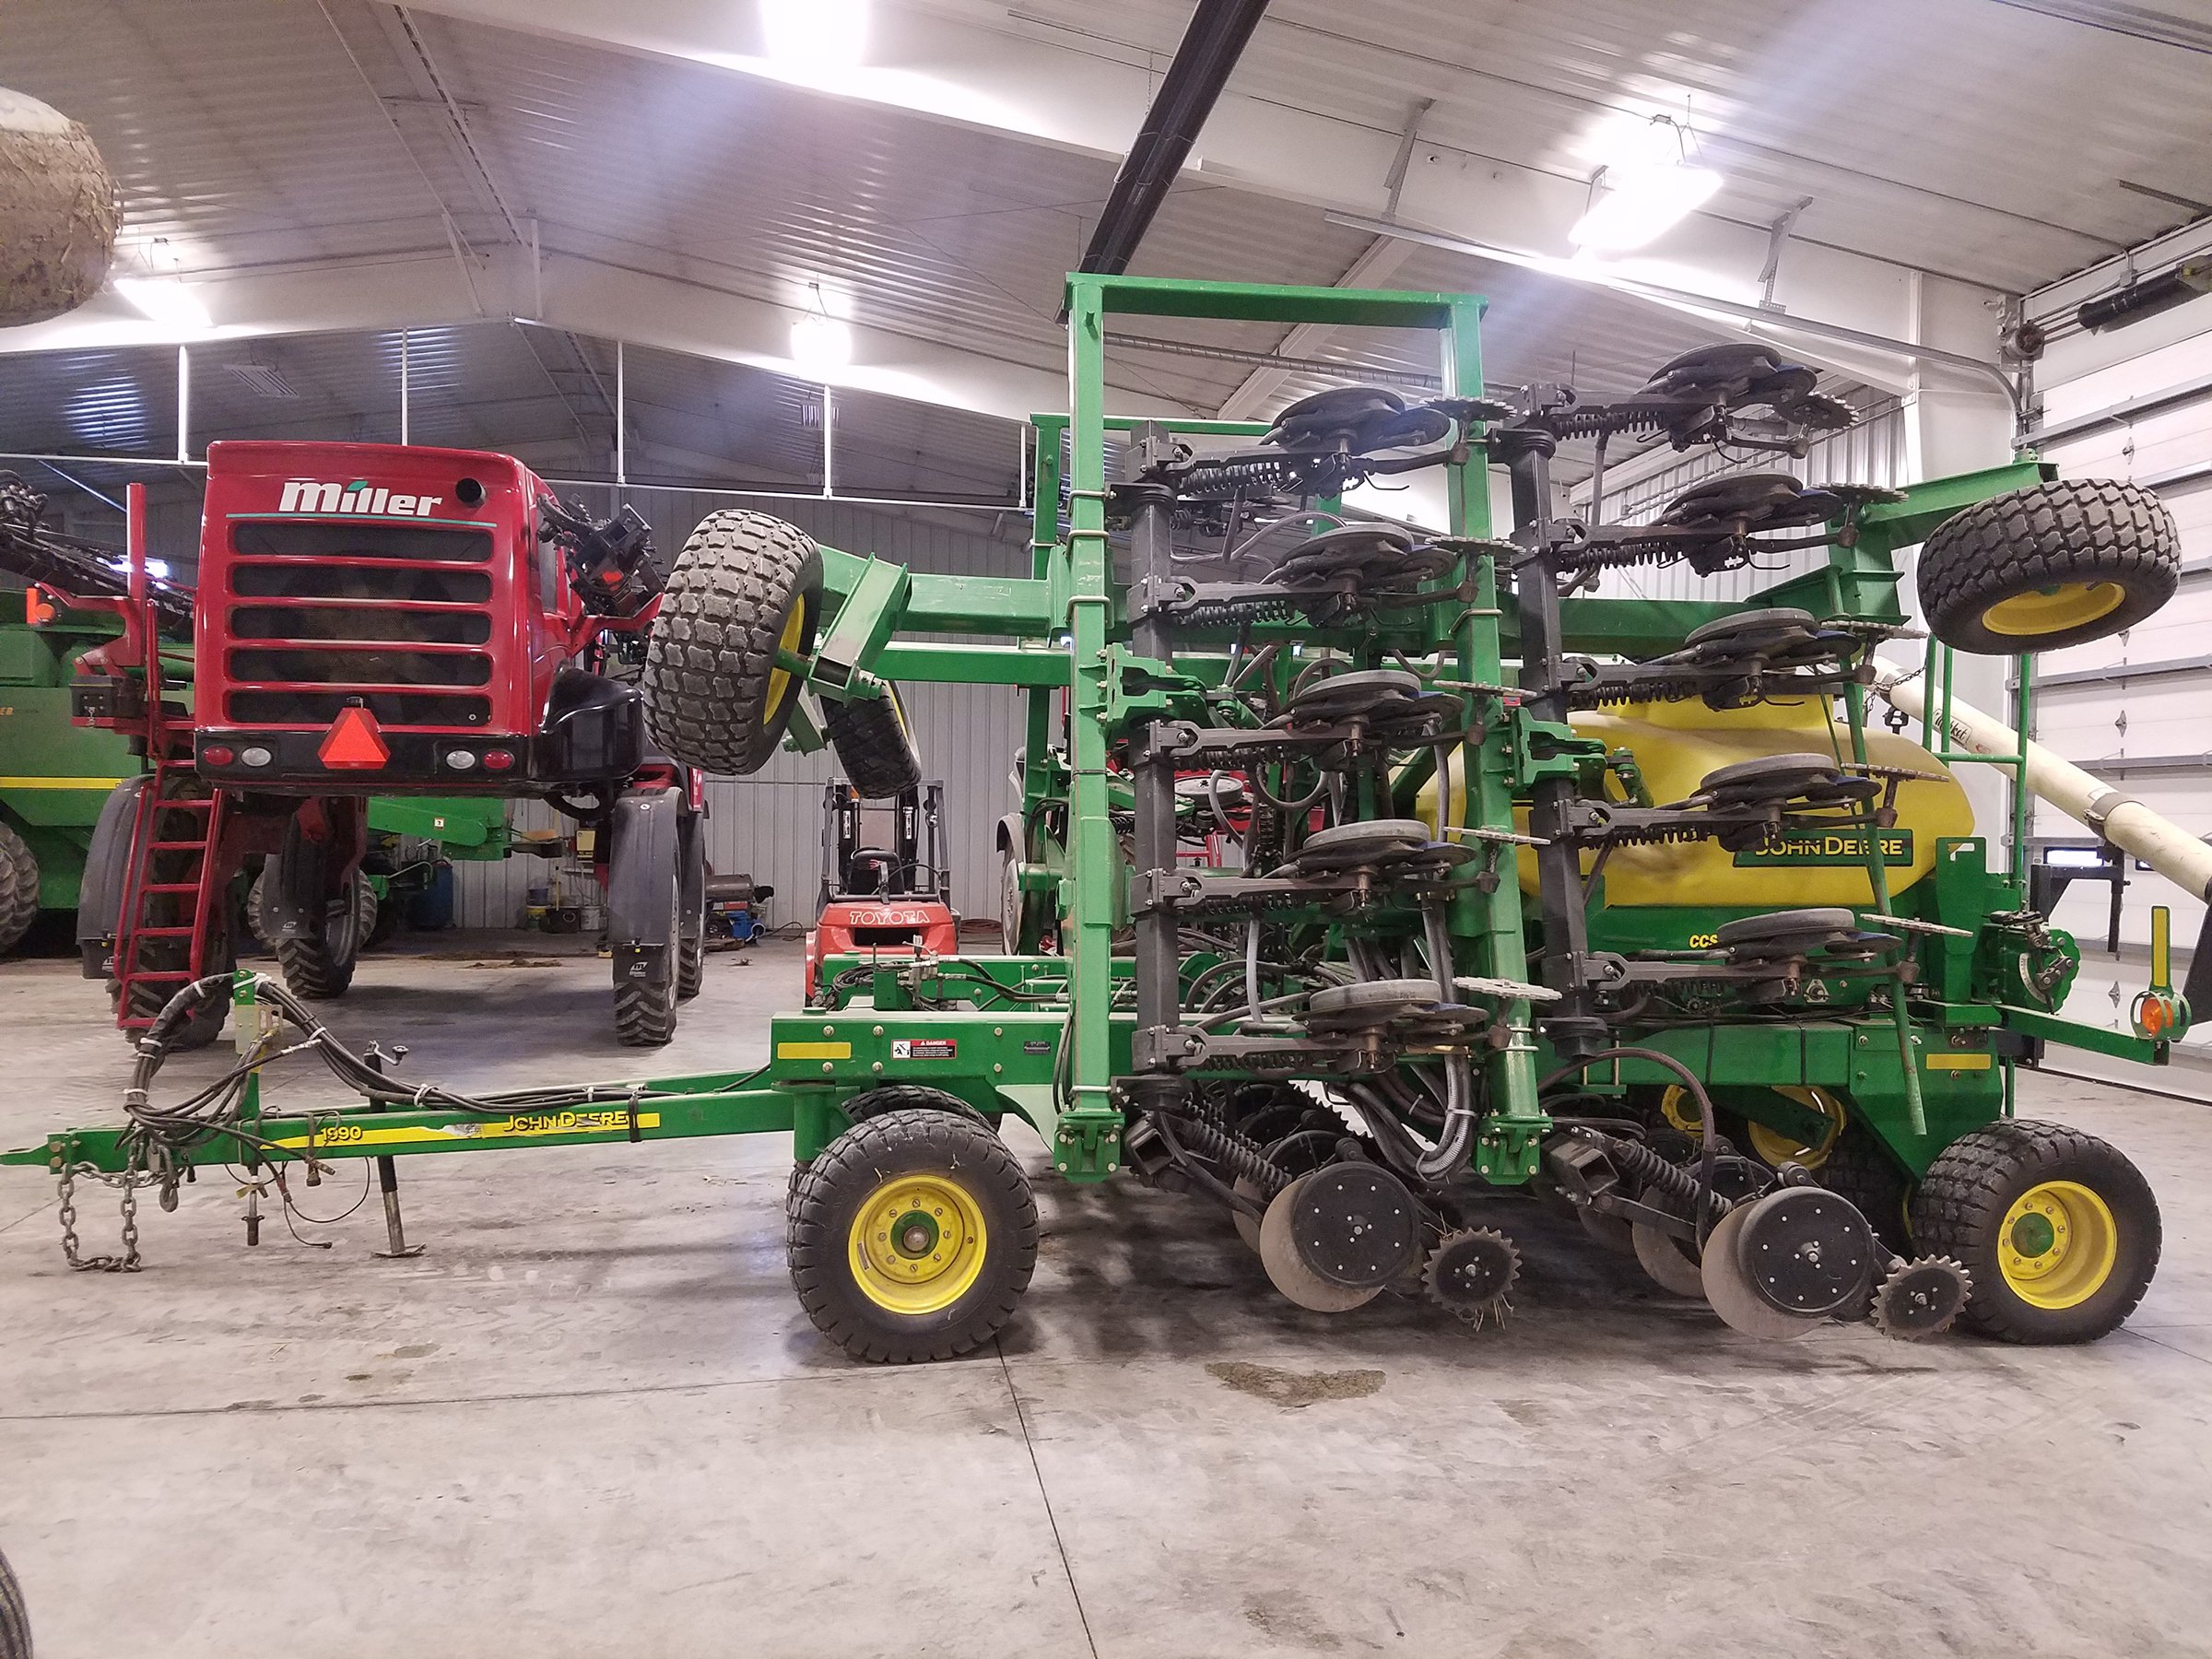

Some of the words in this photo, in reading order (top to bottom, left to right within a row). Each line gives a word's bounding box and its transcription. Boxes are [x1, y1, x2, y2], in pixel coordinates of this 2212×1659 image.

[278, 481, 442, 516] Miller
[1755, 837, 1820, 855] JOHN
[1825, 836, 1903, 855] DEERE
[850, 911, 930, 924] TOYOTA
[1689, 934, 1718, 948] CCS
[321, 1125, 362, 1142] 1990
